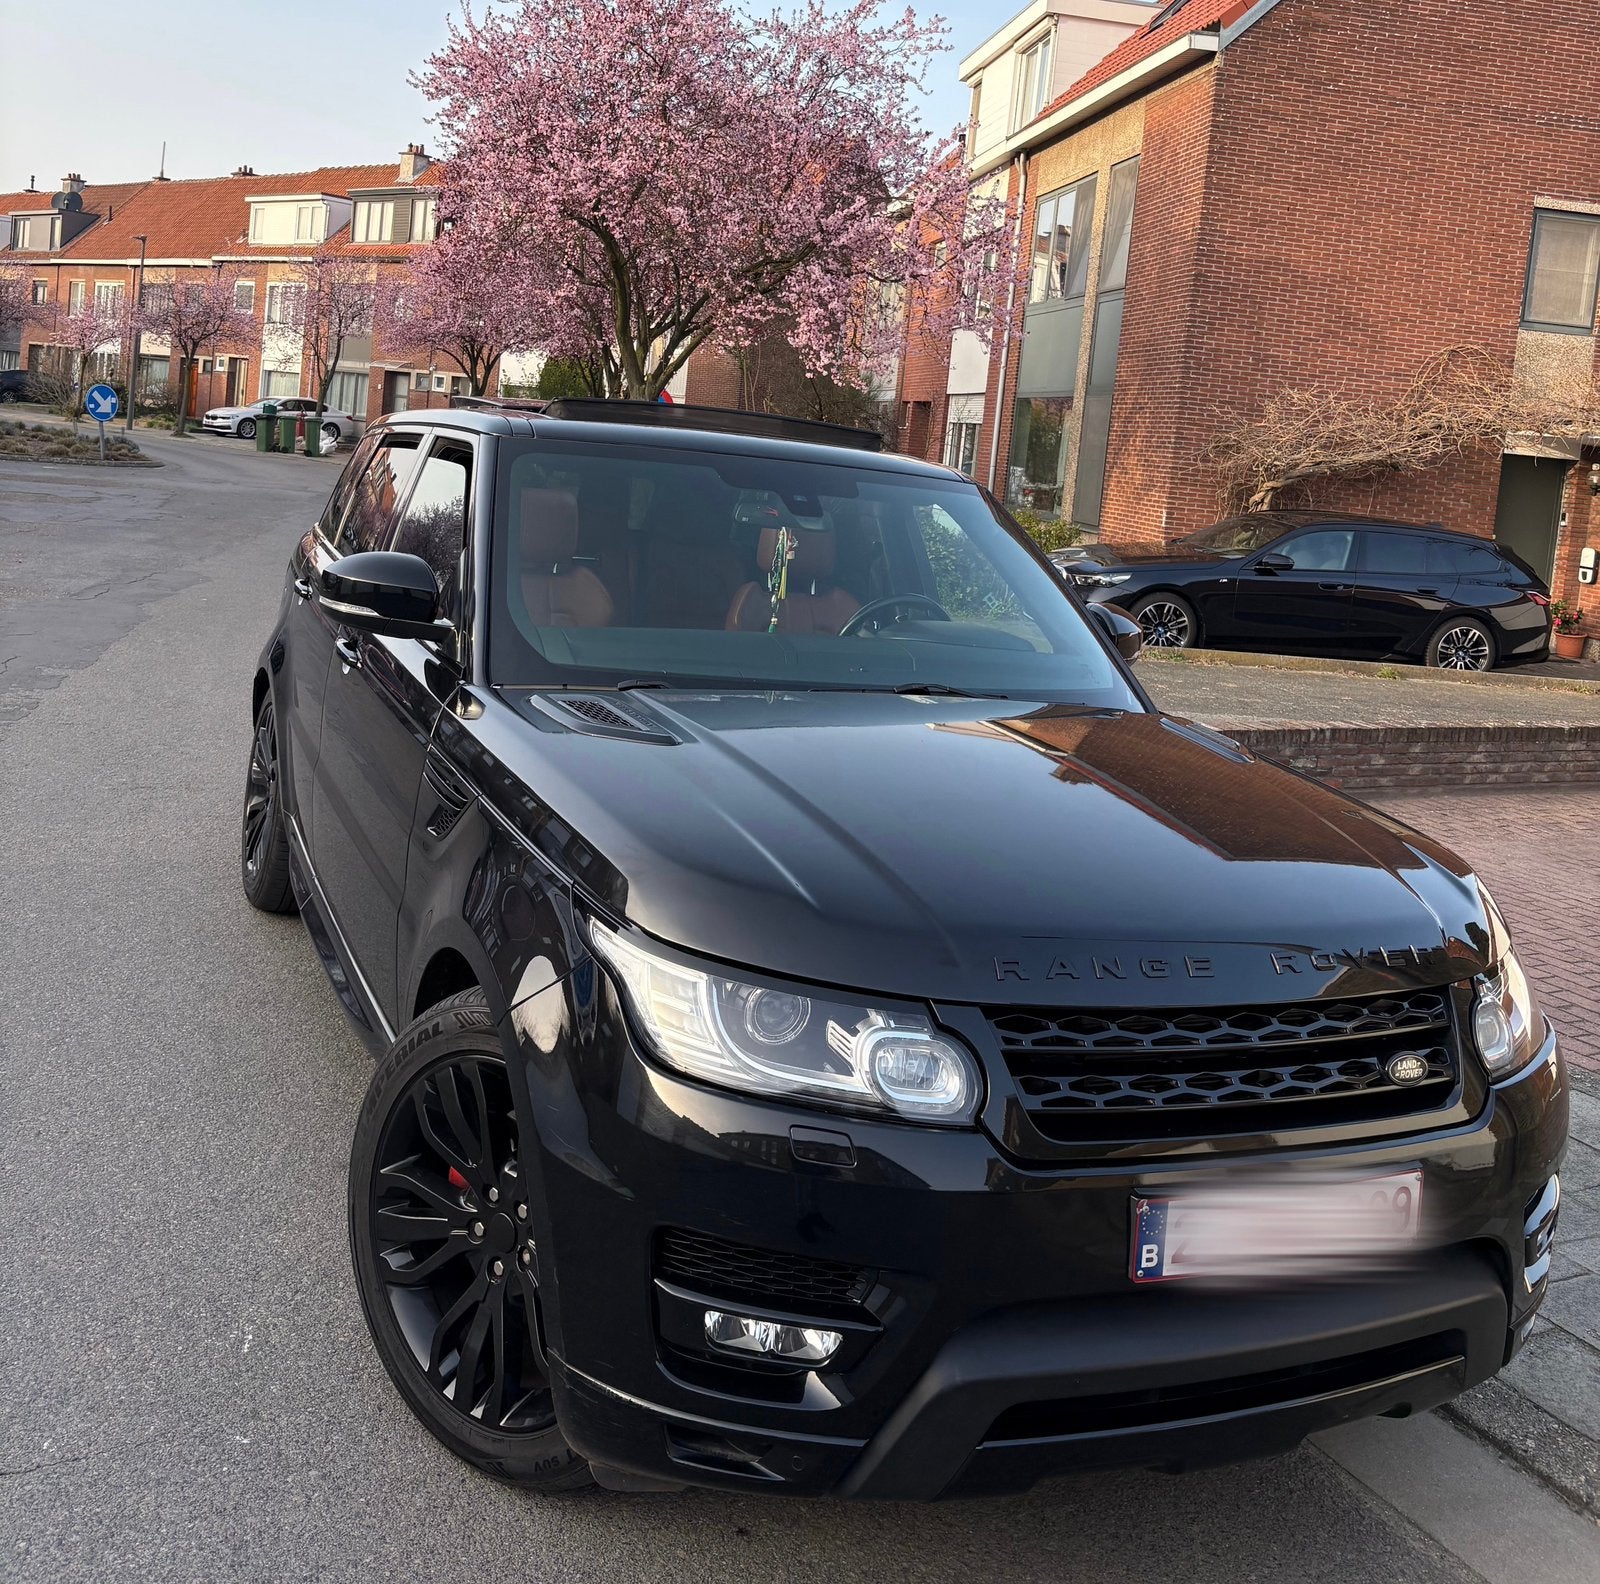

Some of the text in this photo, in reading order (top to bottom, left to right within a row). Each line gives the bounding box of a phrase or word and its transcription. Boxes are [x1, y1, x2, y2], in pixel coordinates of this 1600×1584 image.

[993, 943, 1437, 981] RANGE ROVER
[1397, 1060, 1417, 1070] LAND
[1400, 1068, 1423, 1079] ROVER
[1141, 1244, 1159, 1268] B
[534, 1456, 561, 1473] SUV
